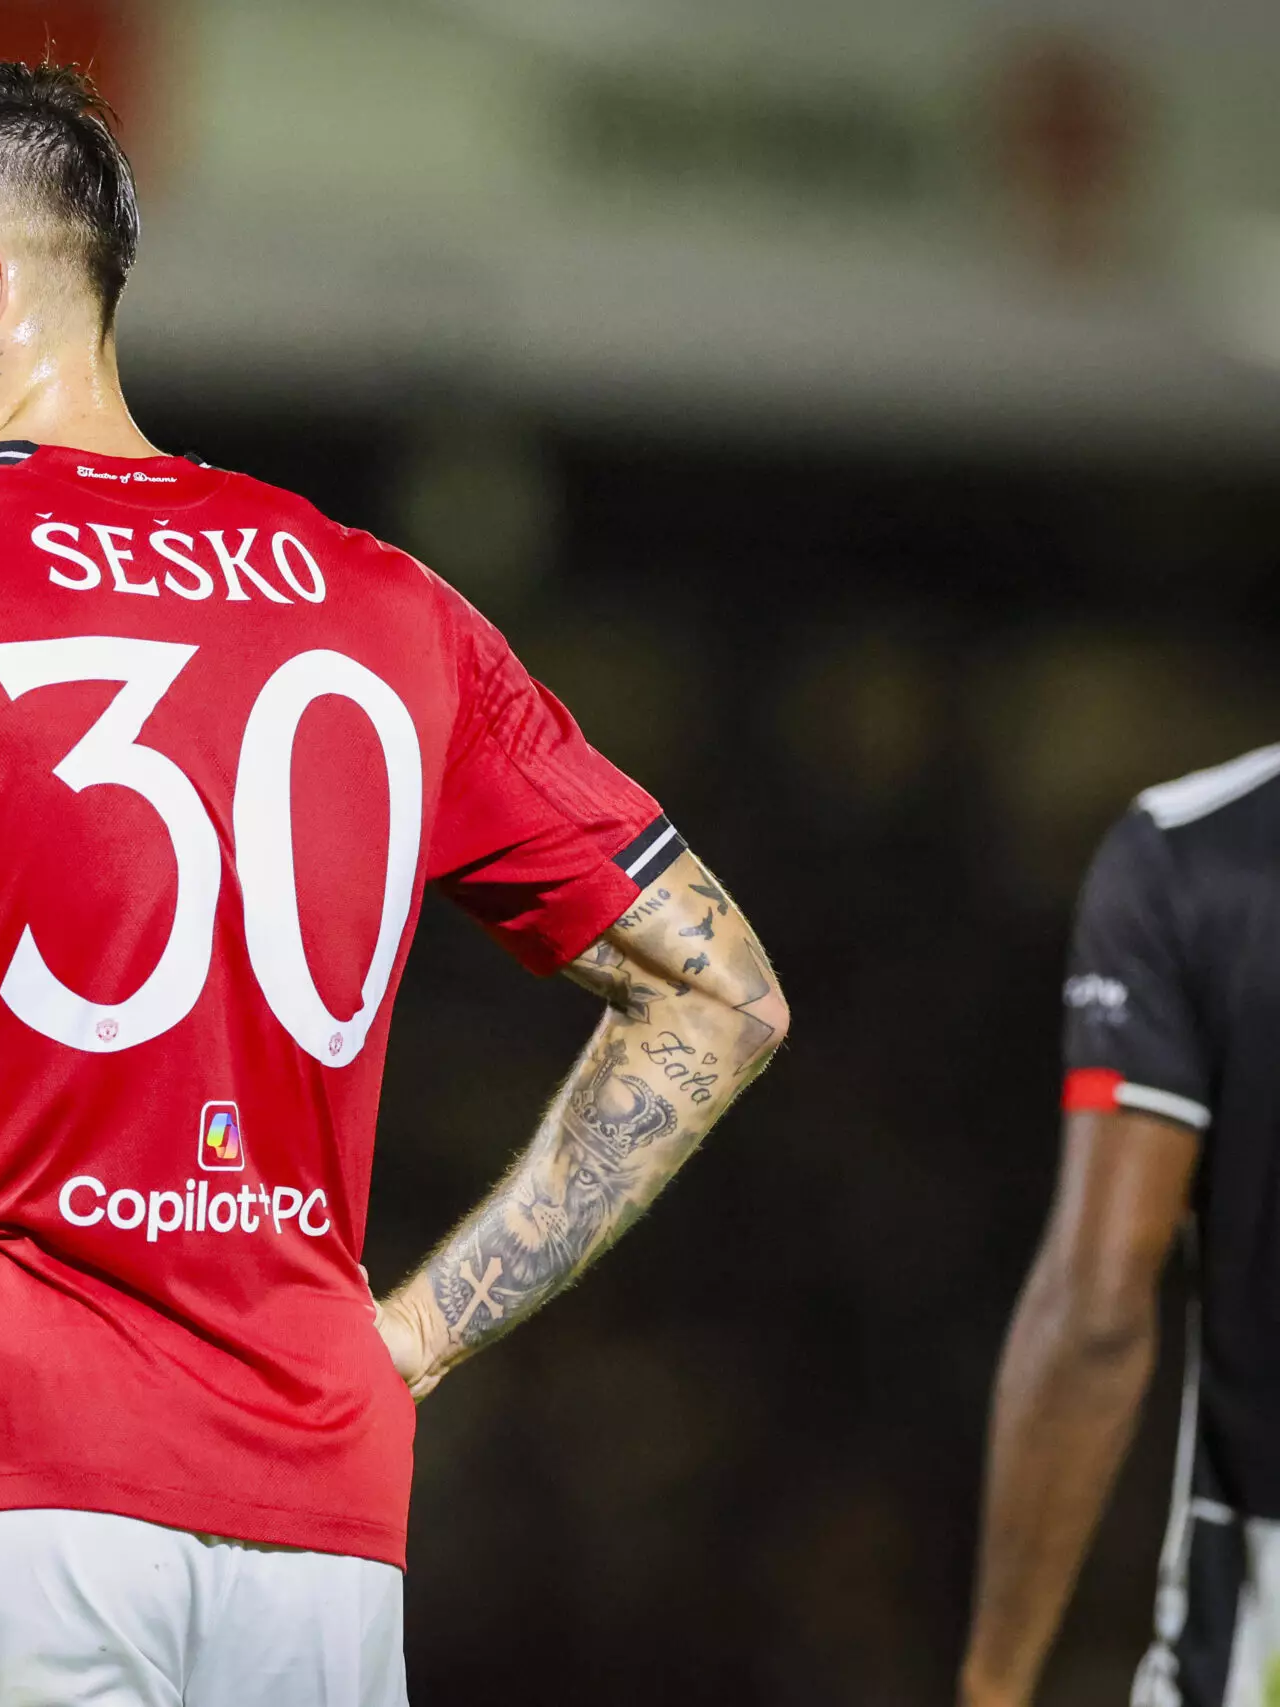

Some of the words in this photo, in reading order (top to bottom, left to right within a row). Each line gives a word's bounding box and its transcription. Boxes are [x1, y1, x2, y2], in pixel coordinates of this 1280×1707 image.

[77, 465, 118, 480] Theatre
[119, 472, 131, 484] of
[133, 471, 177, 483] Dreams
[31, 512, 326, 604] ŠEŠKO
